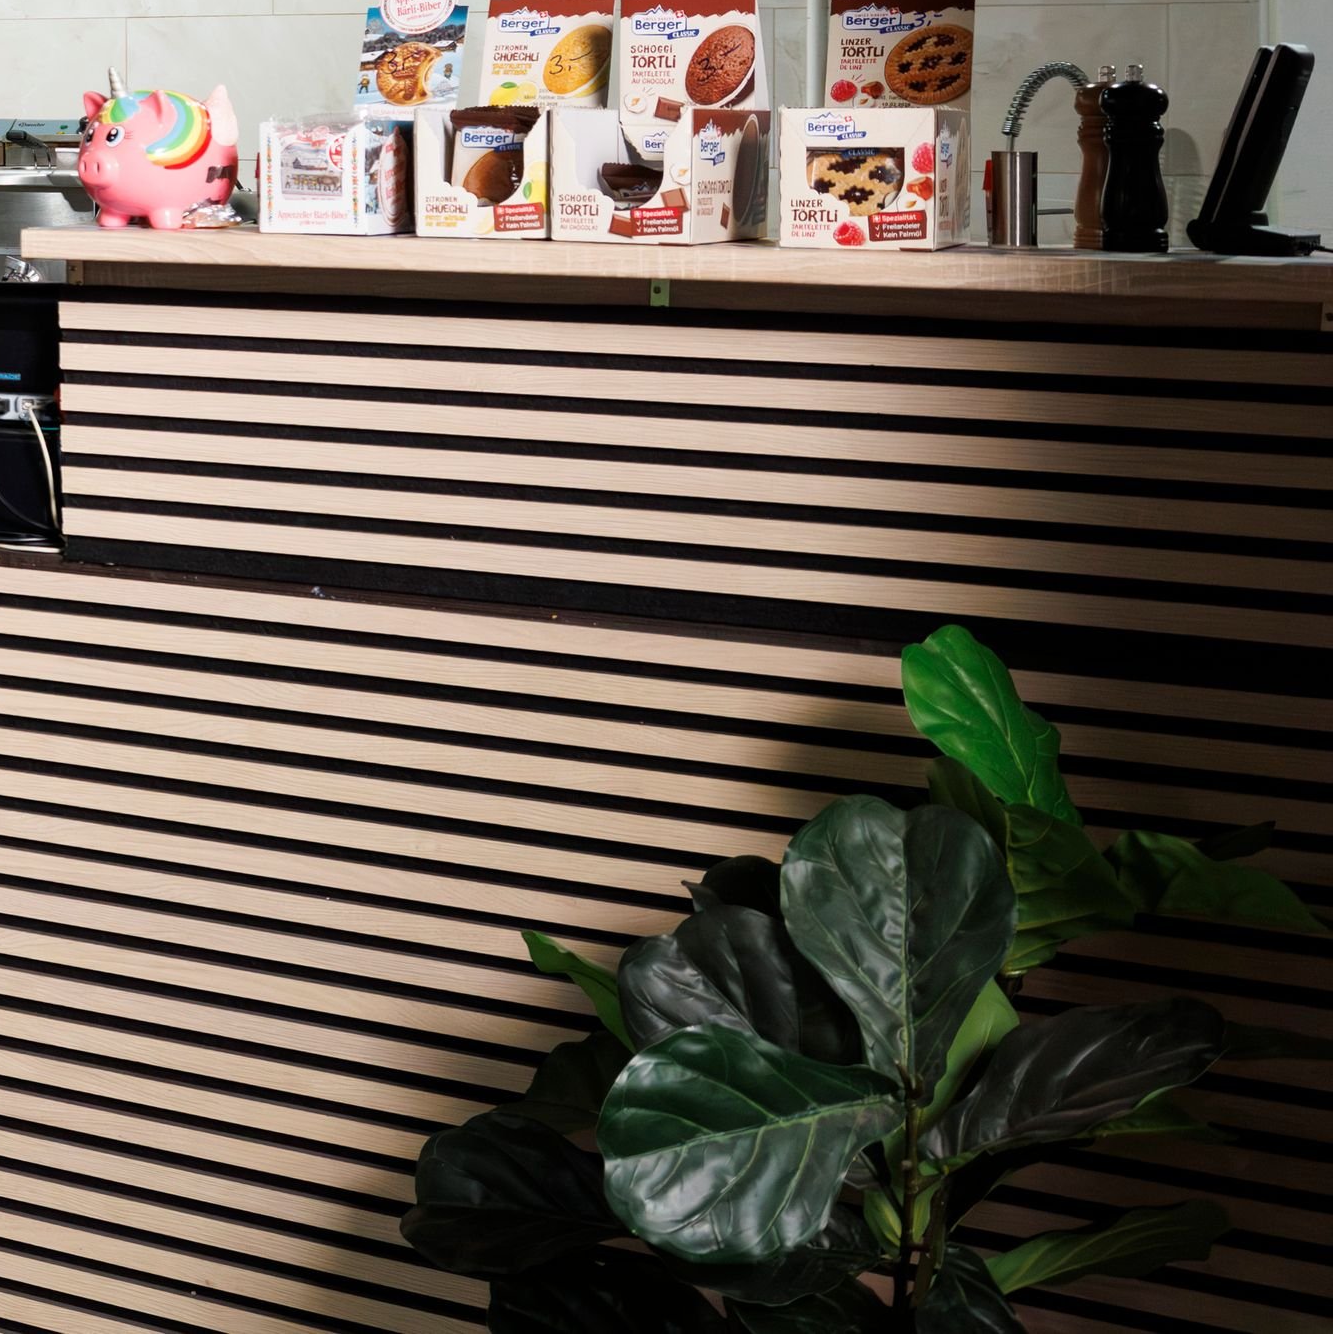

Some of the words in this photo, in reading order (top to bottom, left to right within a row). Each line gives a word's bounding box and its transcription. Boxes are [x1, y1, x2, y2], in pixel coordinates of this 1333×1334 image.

[501, 19, 545, 30] Berger
[635, 20, 683, 32] Berger
[846, 16, 896, 27] Berger
[840, 38, 871, 46] LINZER
[808, 123, 850, 134] Berger
[464, 133, 510, 145] Berger
[790, 199, 823, 207] LINZER
